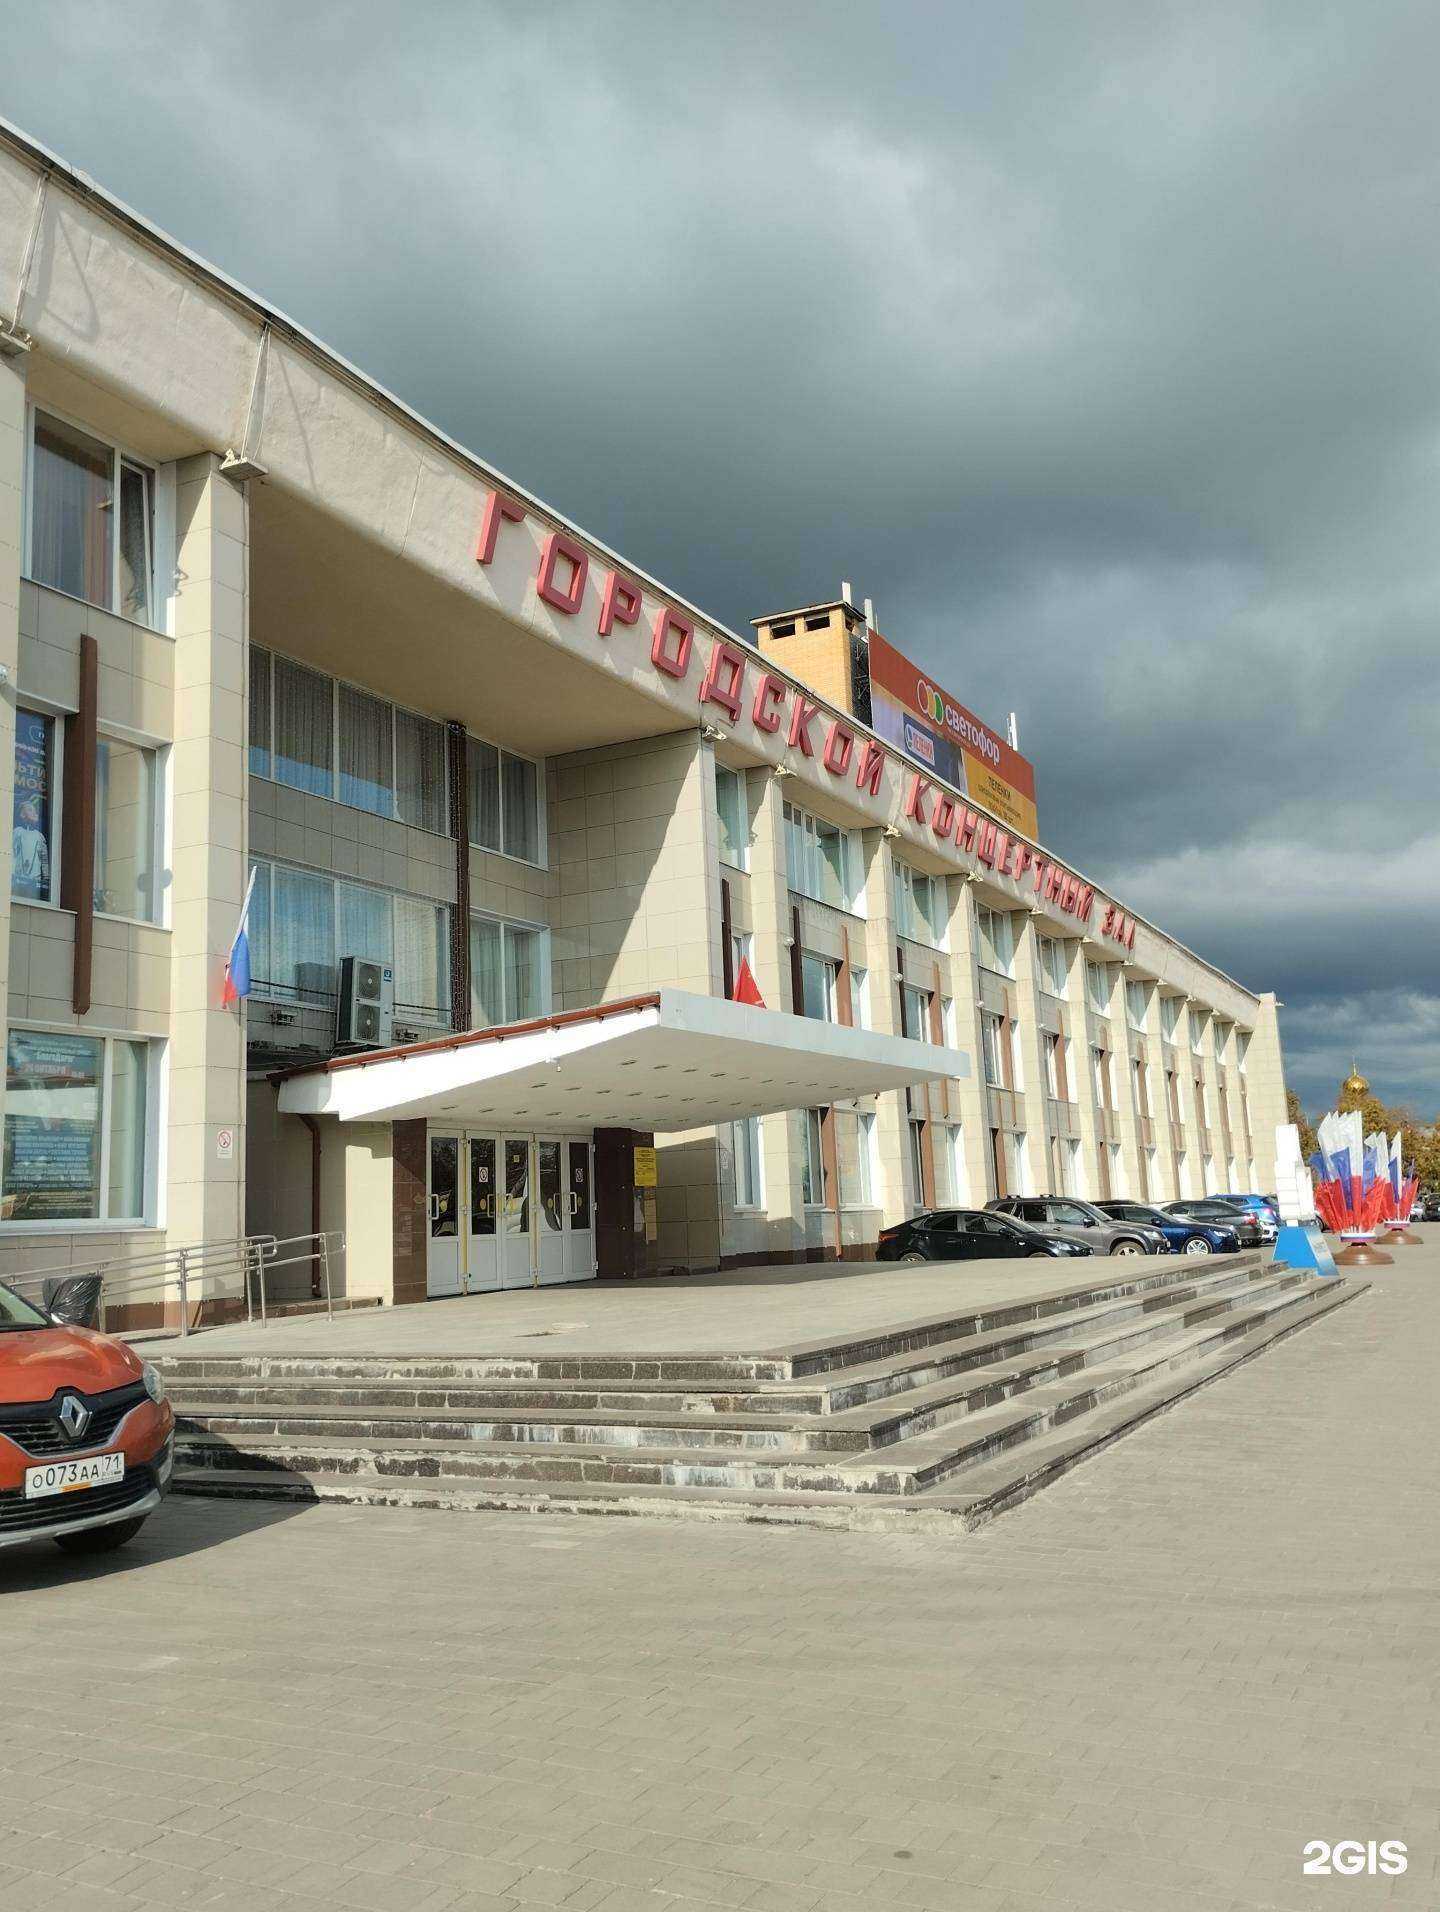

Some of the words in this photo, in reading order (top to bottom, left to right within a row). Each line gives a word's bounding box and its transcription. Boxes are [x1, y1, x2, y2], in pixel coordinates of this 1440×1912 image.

[476, 490, 885, 796] ГОРОДСКОЙ
[905, 774, 1095, 922] КОНЦЕРТНЫЙ
[1101, 902, 1136, 950] ЗАЛ
[945, 704, 1000, 765] светофор
